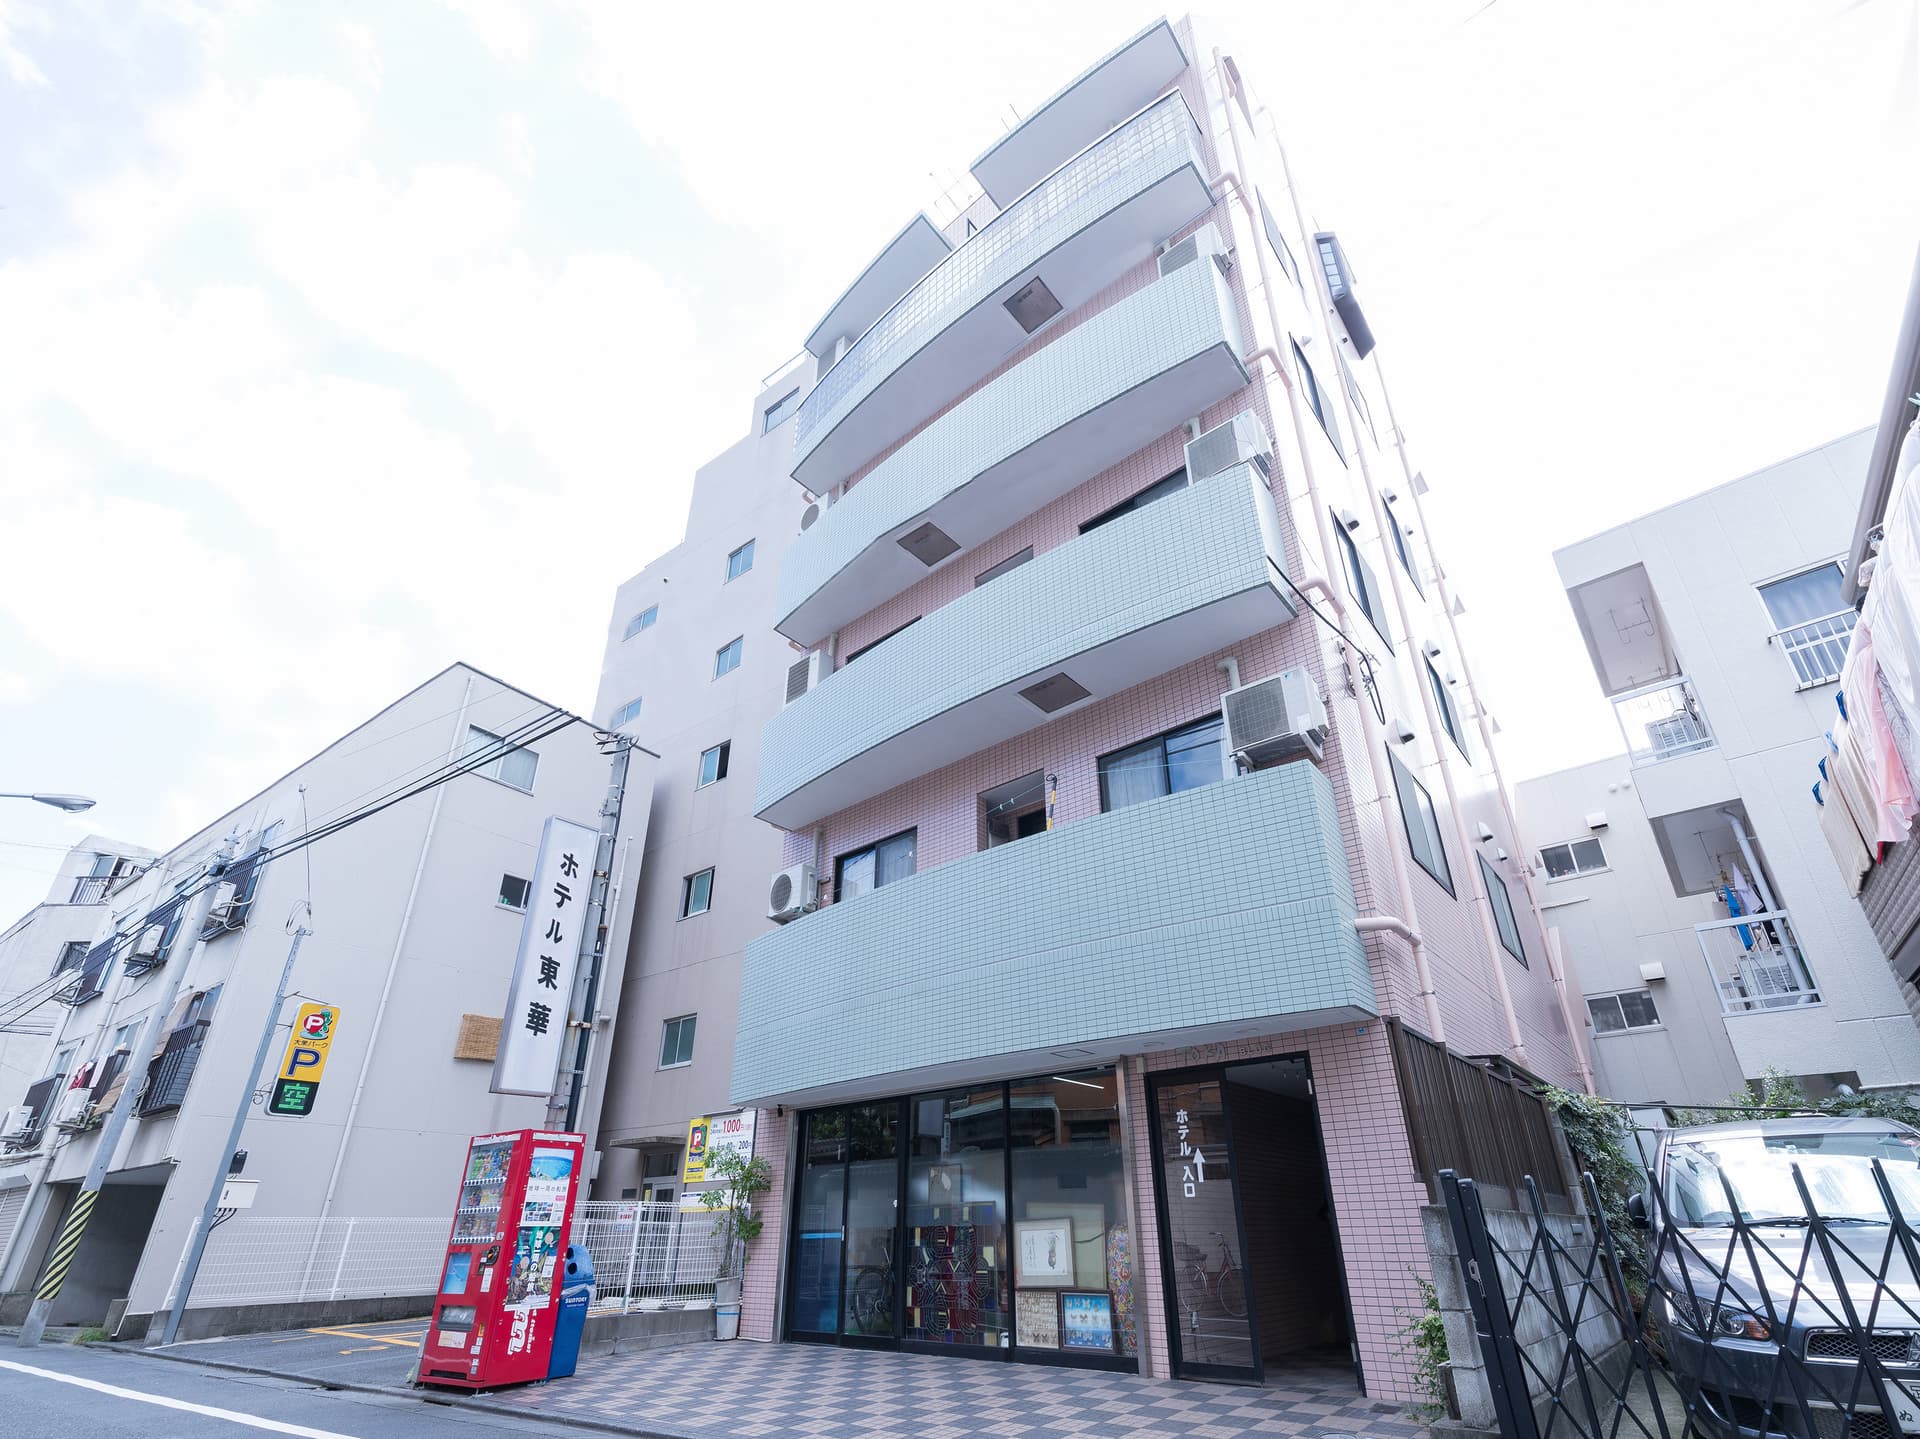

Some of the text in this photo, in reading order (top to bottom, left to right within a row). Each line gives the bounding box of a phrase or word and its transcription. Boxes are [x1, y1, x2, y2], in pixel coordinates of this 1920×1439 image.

[525, 852, 579, 1037] ホテル東華
[306, 1015, 324, 1030] P
[286, 1047, 321, 1077] P
[278, 1083, 310, 1110] 空
